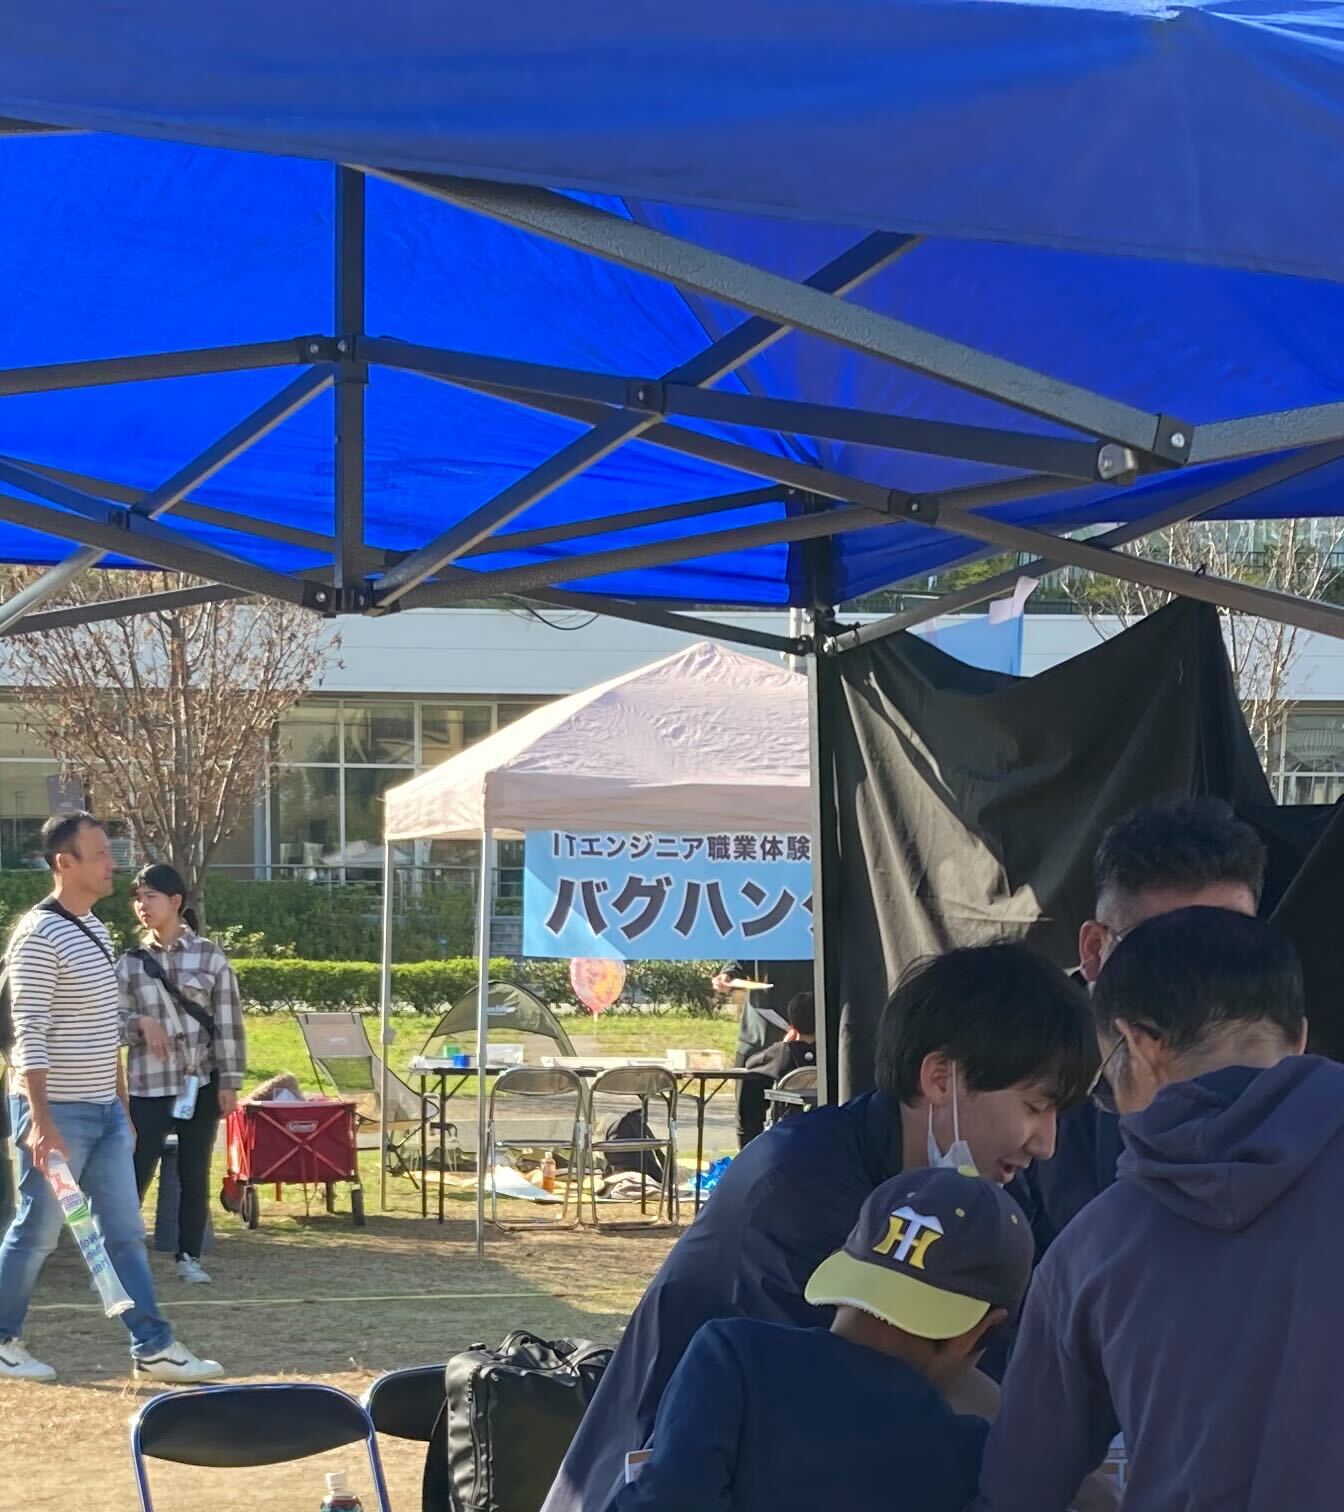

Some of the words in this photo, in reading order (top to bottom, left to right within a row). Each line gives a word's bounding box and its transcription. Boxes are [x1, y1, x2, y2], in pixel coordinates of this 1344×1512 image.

[552, 832, 812, 862] ITエンジニア職業体験
[544, 875, 814, 941] バグハン
